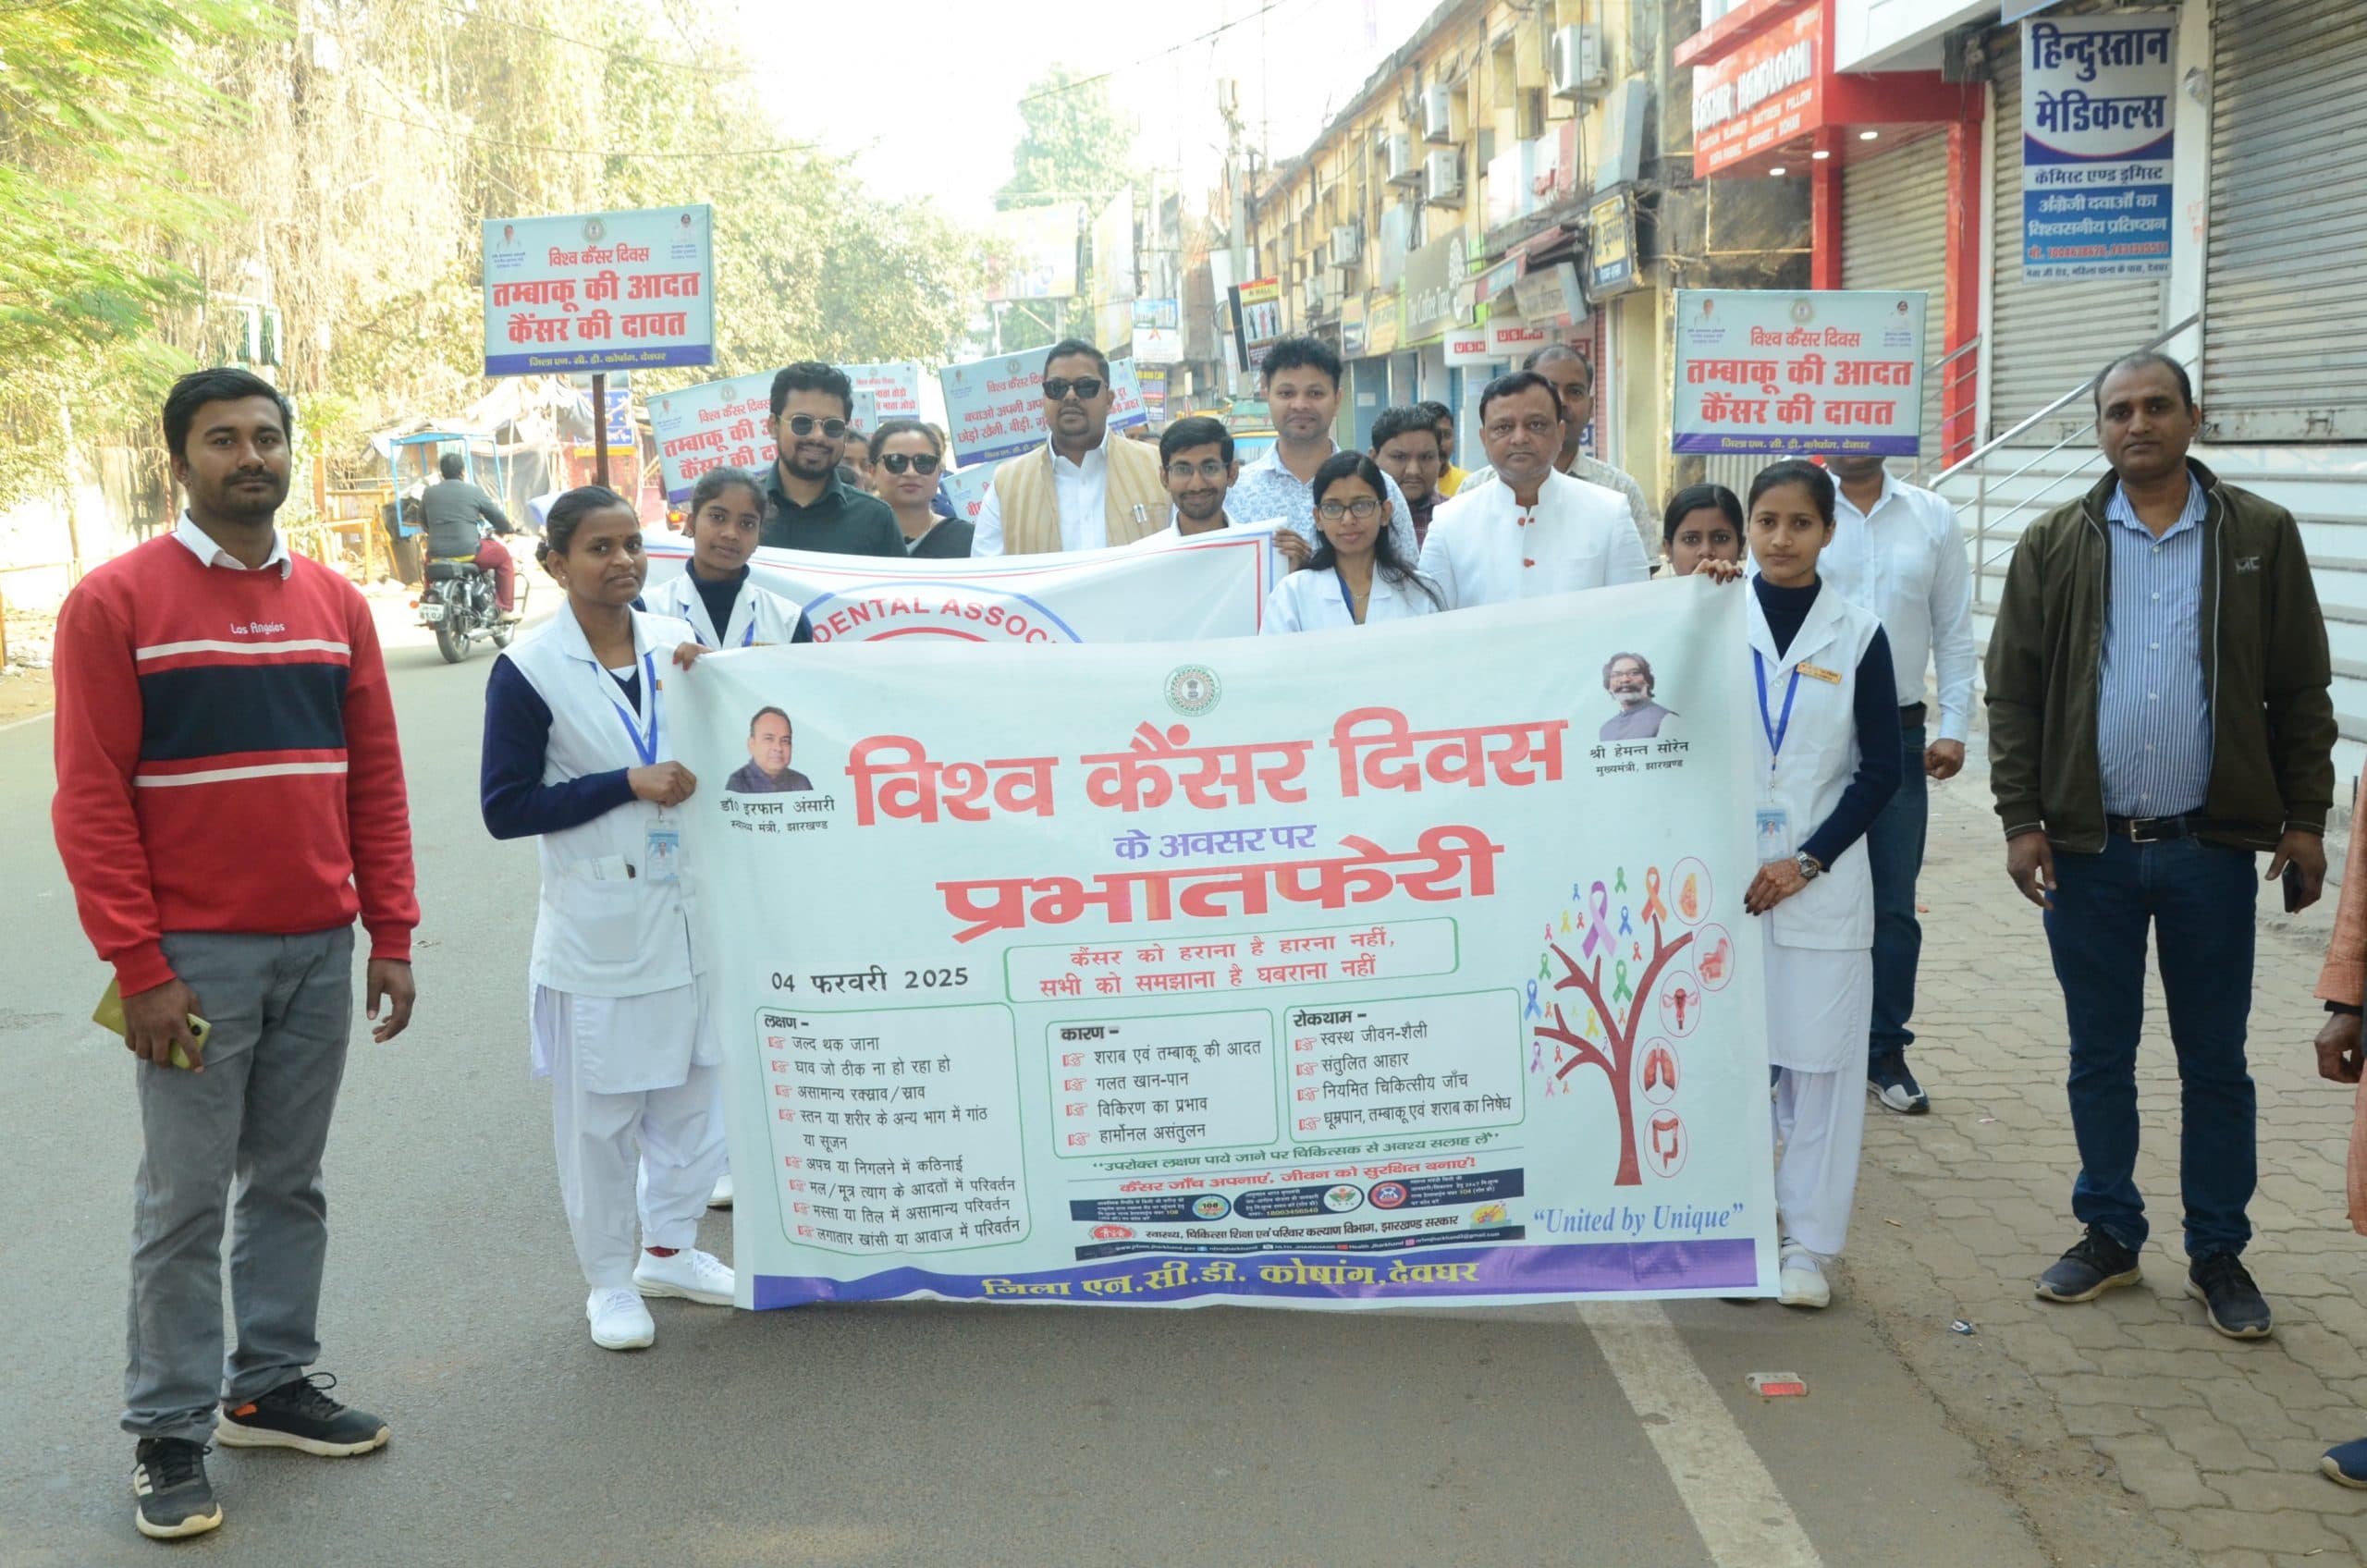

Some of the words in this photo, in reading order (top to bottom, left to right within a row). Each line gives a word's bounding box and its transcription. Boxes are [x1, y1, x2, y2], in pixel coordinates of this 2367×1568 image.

[2031, 22, 2172, 81] हिन्दुस्तान
[2035, 90, 2168, 132] मेडिकल्स
[2137, 193, 2159, 208] का
[548, 246, 578, 266] विश्व
[616, 242, 651, 263] दिवस
[492, 278, 581, 312] तम्बाकू
[584, 270, 620, 300] की
[628, 272, 701, 300] आदत
[508, 312, 570, 344] कैंसर
[576, 309, 612, 340] की
[620, 312, 687, 339] दावत
[1750, 326, 1782, 347] विश्व
[1823, 326, 1860, 347] दिवस
[1686, 359, 1781, 395] तम्बाकू
[1786, 353, 1827, 385] की
[1834, 361, 1914, 386] आदत
[1700, 392, 1769, 423] कैंसर
[1776, 393, 1815, 424] की
[1823, 400, 1896, 425] दावत
[662, 425, 729, 459] तम्बाकू
[729, 418, 755, 441] की
[230, 622, 249, 634] Los
[251, 621, 286, 635] Angeles
[813, 598, 930, 643] DENTAL
[1590, 745, 1606, 759] श्री
[1614, 743, 1649, 757] हेमन्त
[1657, 739, 1689, 753] सोरेन
[844, 734, 1060, 827] विश्व
[1080, 720, 1313, 809] कैंसर
[1330, 705, 1569, 798] दिवस
[742, 802, 784, 817] इरफान
[792, 794, 836, 813] अंसारी
[1113, 830, 1148, 860] के
[1159, 827, 1266, 858] अवसर
[1272, 824, 1317, 850] पर
[936, 826, 1505, 944] प्रभातफेरी
[1071, 946, 1122, 968] कैंसर
[1137, 943, 1165, 963] को
[1179, 943, 1236, 962] हराना
[1250, 936, 1265, 957] है
[772, 972, 795, 992] 04
[811, 964, 888, 994] फरवरी
[905, 968, 969, 989] 2025
[1040, 972, 1082, 998] सभी
[1096, 972, 1122, 995] को
[1135, 970, 1216, 993] समझाना
[1230, 963, 1244, 987] है
[1257, 962, 1328, 985] घबराना
[1341, 952, 1377, 977] नहीं
[764, 1013, 797, 1030] लक्षण
[791, 1035, 816, 1051] जल्द
[823, 1036, 844, 1051] थक
[850, 1036, 880, 1051] जाना
[1061, 1025, 1105, 1042] कारण
[1320, 1030, 1355, 1047] स्वस्थ
[1094, 1047, 1126, 1065] शराब
[1133, 1045, 1152, 1064] एवं
[1157, 1045, 1201, 1063] तम्बाकू
[1204, 1039, 1220, 1057] की
[1227, 1040, 1262, 1056] आदत
[1321, 1052, 1367, 1076] संतुलित
[1373, 1051, 1409, 1068] आहार
[795, 1060, 816, 1075] घाव
[820, 1058, 836, 1076] जो
[841, 1059, 865, 1077] ठीक
[873, 1062, 886, 1076] ना
[891, 1056, 905, 1075] हो
[912, 1060, 932, 1074] रहा
[937, 1054, 951, 1073] हो
[797, 1084, 845, 1101] असामान्य
[1096, 1075, 1127, 1092] गलत
[1323, 1080, 1368, 1100] नियमित
[800, 1109, 823, 1125] स्तन
[828, 1110, 840, 1125] या
[844, 1108, 871, 1127] शरीर
[877, 1107, 888, 1125] के
[893, 1110, 918, 1125] अन्य
[924, 1109, 947, 1124] भाग
[951, 1104, 963, 1121] में
[1097, 1098, 1147, 1119] विकिरण
[1152, 1098, 1170, 1113] का
[1176, 1096, 1208, 1113] प्रभाव
[1430, 1100, 1461, 1118] शराब
[1464, 1100, 1479, 1114] का
[803, 1133, 816, 1147] या
[820, 1134, 848, 1154] सूजन
[1153, 1121, 1207, 1144] असंतुलन
[1162, 1156, 1201, 1170] लक्षण
[1234, 1149, 1266, 1162] जाने
[1270, 1149, 1290, 1162] पर
[1294, 1145, 1362, 1159] चिकित्सक
[1366, 1142, 1379, 1154] से
[1383, 1140, 1427, 1153] अवश्य
[1430, 1135, 1470, 1148] सलाह
[805, 1156, 831, 1172] अपच
[837, 1158, 849, 1173] या
[855, 1156, 895, 1175] निगलने
[901, 1158, 912, 1174] में
[917, 1154, 963, 1173] कठिनाई
[1280, 1169, 1330, 1183] जीवन
[1334, 1166, 1358, 1179] को
[861, 1184, 887, 1199] त्याग
[892, 1181, 904, 1199] के
[911, 1177, 949, 1197] आदतों
[954, 1176, 964, 1194] में
[971, 1175, 1016, 1193] परिवर्तन
[812, 1204, 839, 1220] मस्सा
[844, 1207, 857, 1222] या
[862, 1206, 885, 1224] तिल
[890, 1205, 901, 1223] में
[906, 1201, 958, 1221] असामान्य
[964, 1198, 1011, 1215] परिवर्तन
[1425, 1215, 1459, 1228] सरकार
[1622, 1205, 1646, 1237] by
[816, 1227, 852, 1245] लगातार
[895, 1231, 909, 1246] या
[914, 1226, 953, 1245] आवाज
[974, 1218, 1021, 1238] परिवर्तन
[981, 1278, 1072, 1295] जिला
